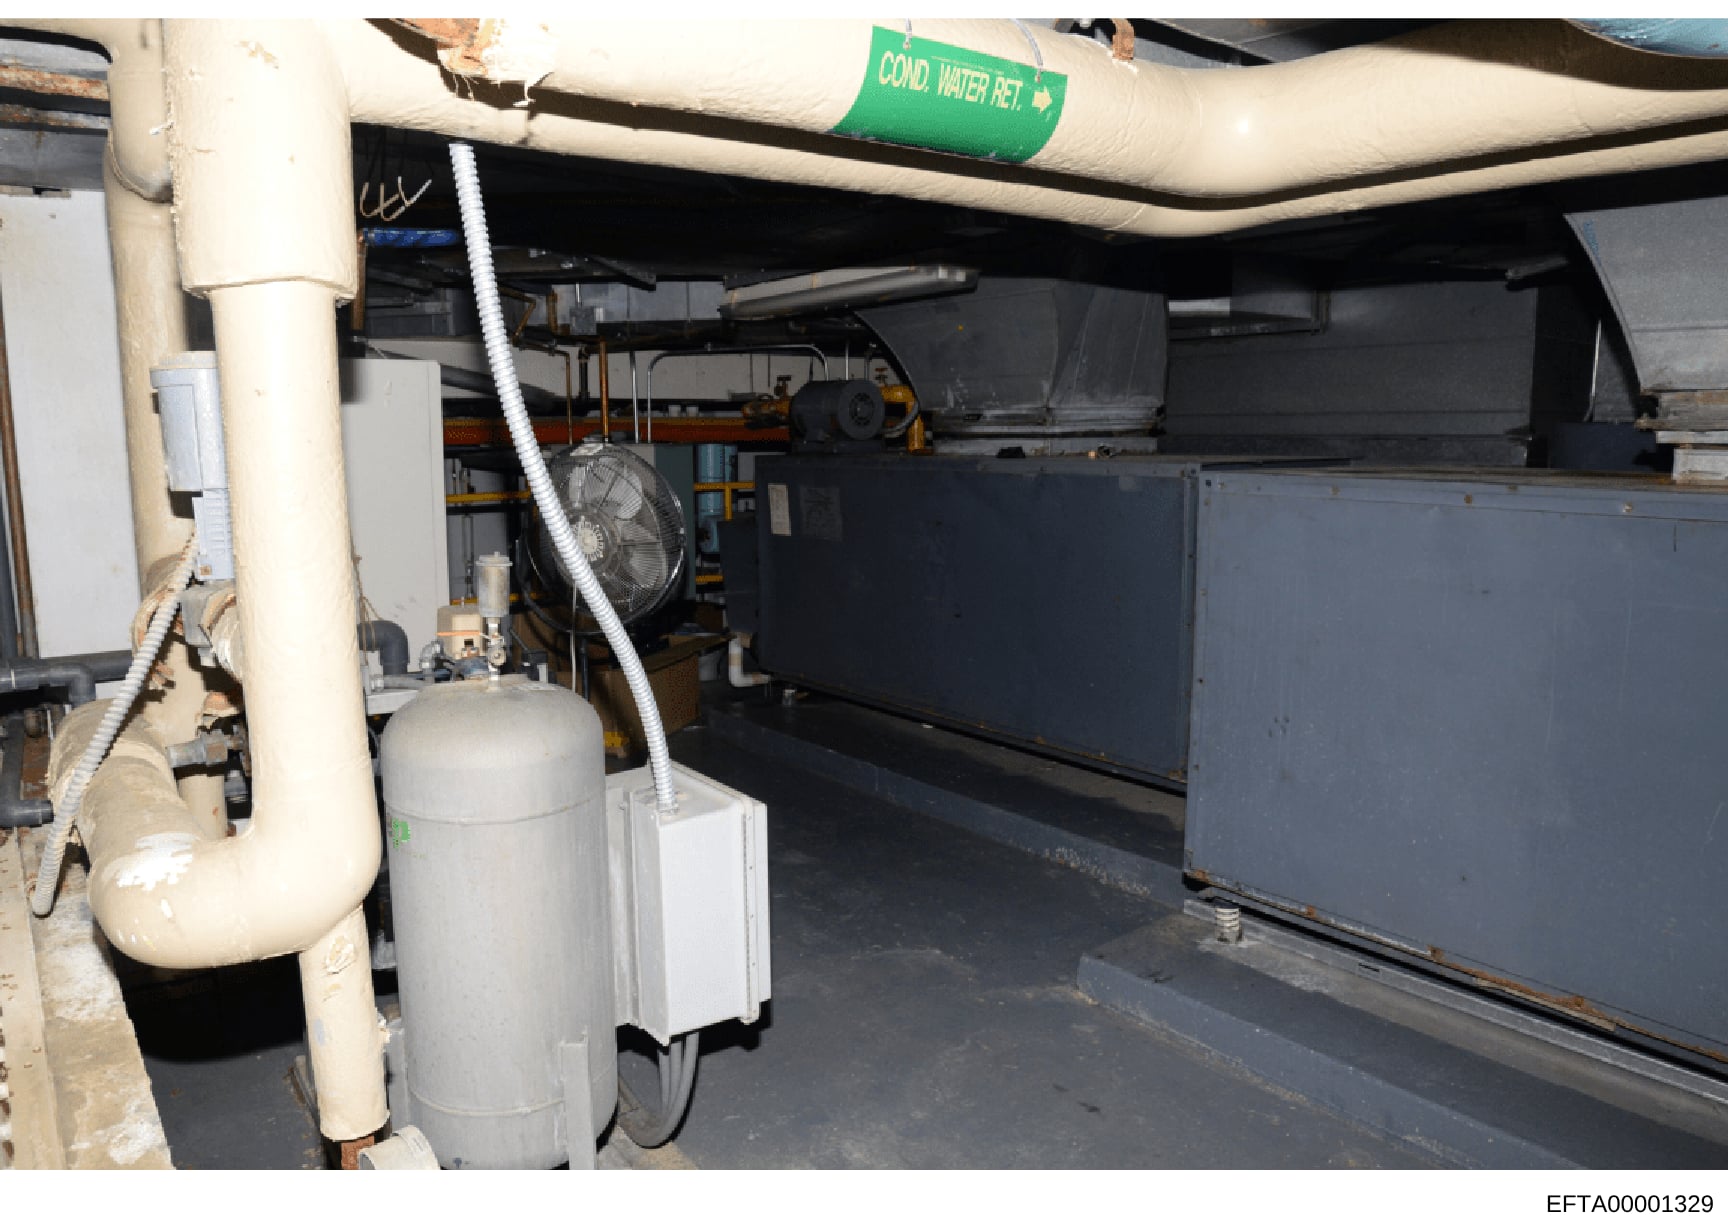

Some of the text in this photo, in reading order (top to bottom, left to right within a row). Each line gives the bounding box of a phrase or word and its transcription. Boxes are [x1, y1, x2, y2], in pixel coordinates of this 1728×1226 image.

[879, 51, 930, 92] COND.
[938, 63, 989, 104] WATER
[990, 77, 1023, 111] RET.
